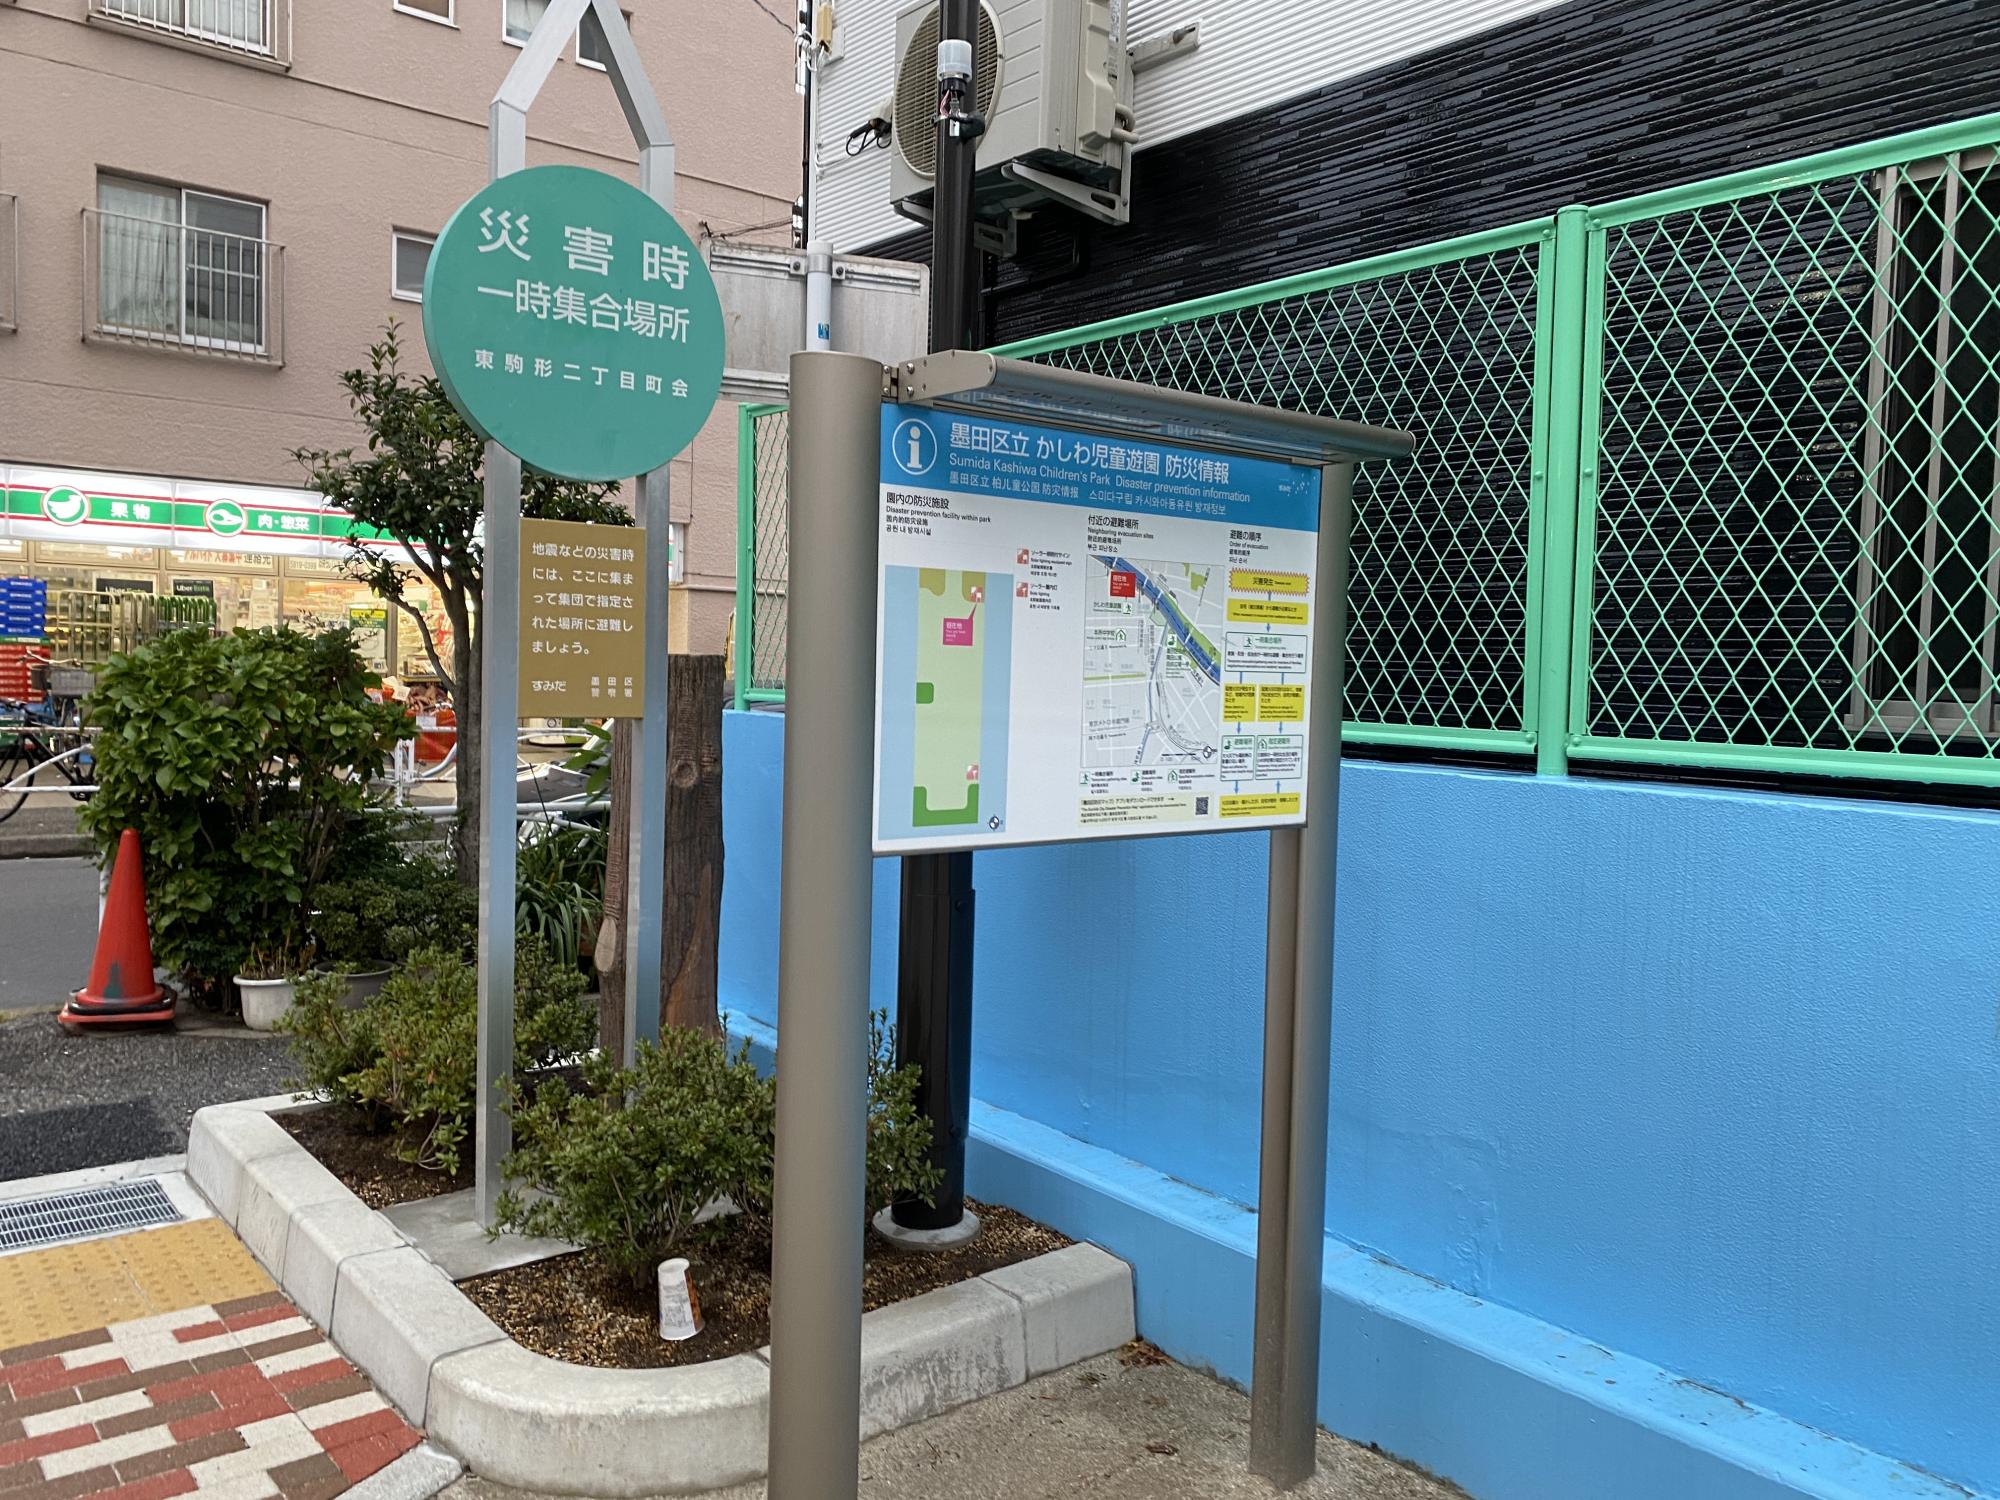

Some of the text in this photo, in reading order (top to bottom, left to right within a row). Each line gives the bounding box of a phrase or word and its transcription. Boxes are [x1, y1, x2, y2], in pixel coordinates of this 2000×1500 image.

[478, 207, 689, 290] 災害時
[478, 279, 689, 343] 一時集合場所
[475, 349, 688, 397] 東駒形二丁目町会
[950, 423, 1229, 484] 墨田区立 かしわ児童遊園 防災情報
[950, 453, 1250, 503] Sumida Kashiwa Children's Park Disaster prevention information
[886, 492, 949, 510] 園内の防災施設
[886, 506, 909, 515] Disaster
[911, 509, 941, 519] prevention
[979, 516, 991, 524] park
[1088, 514, 1139, 530] 付近の避難場所
[532, 543, 634, 562] 地震などの災害時
[532, 566, 633, 585] には、ここに集ま
[533, 592, 633, 609] って集団で指定さ
[532, 616, 632, 632] れた場所に避難し
[532, 641, 589, 655] ましょう。
[532, 679, 566, 692] すみだ
